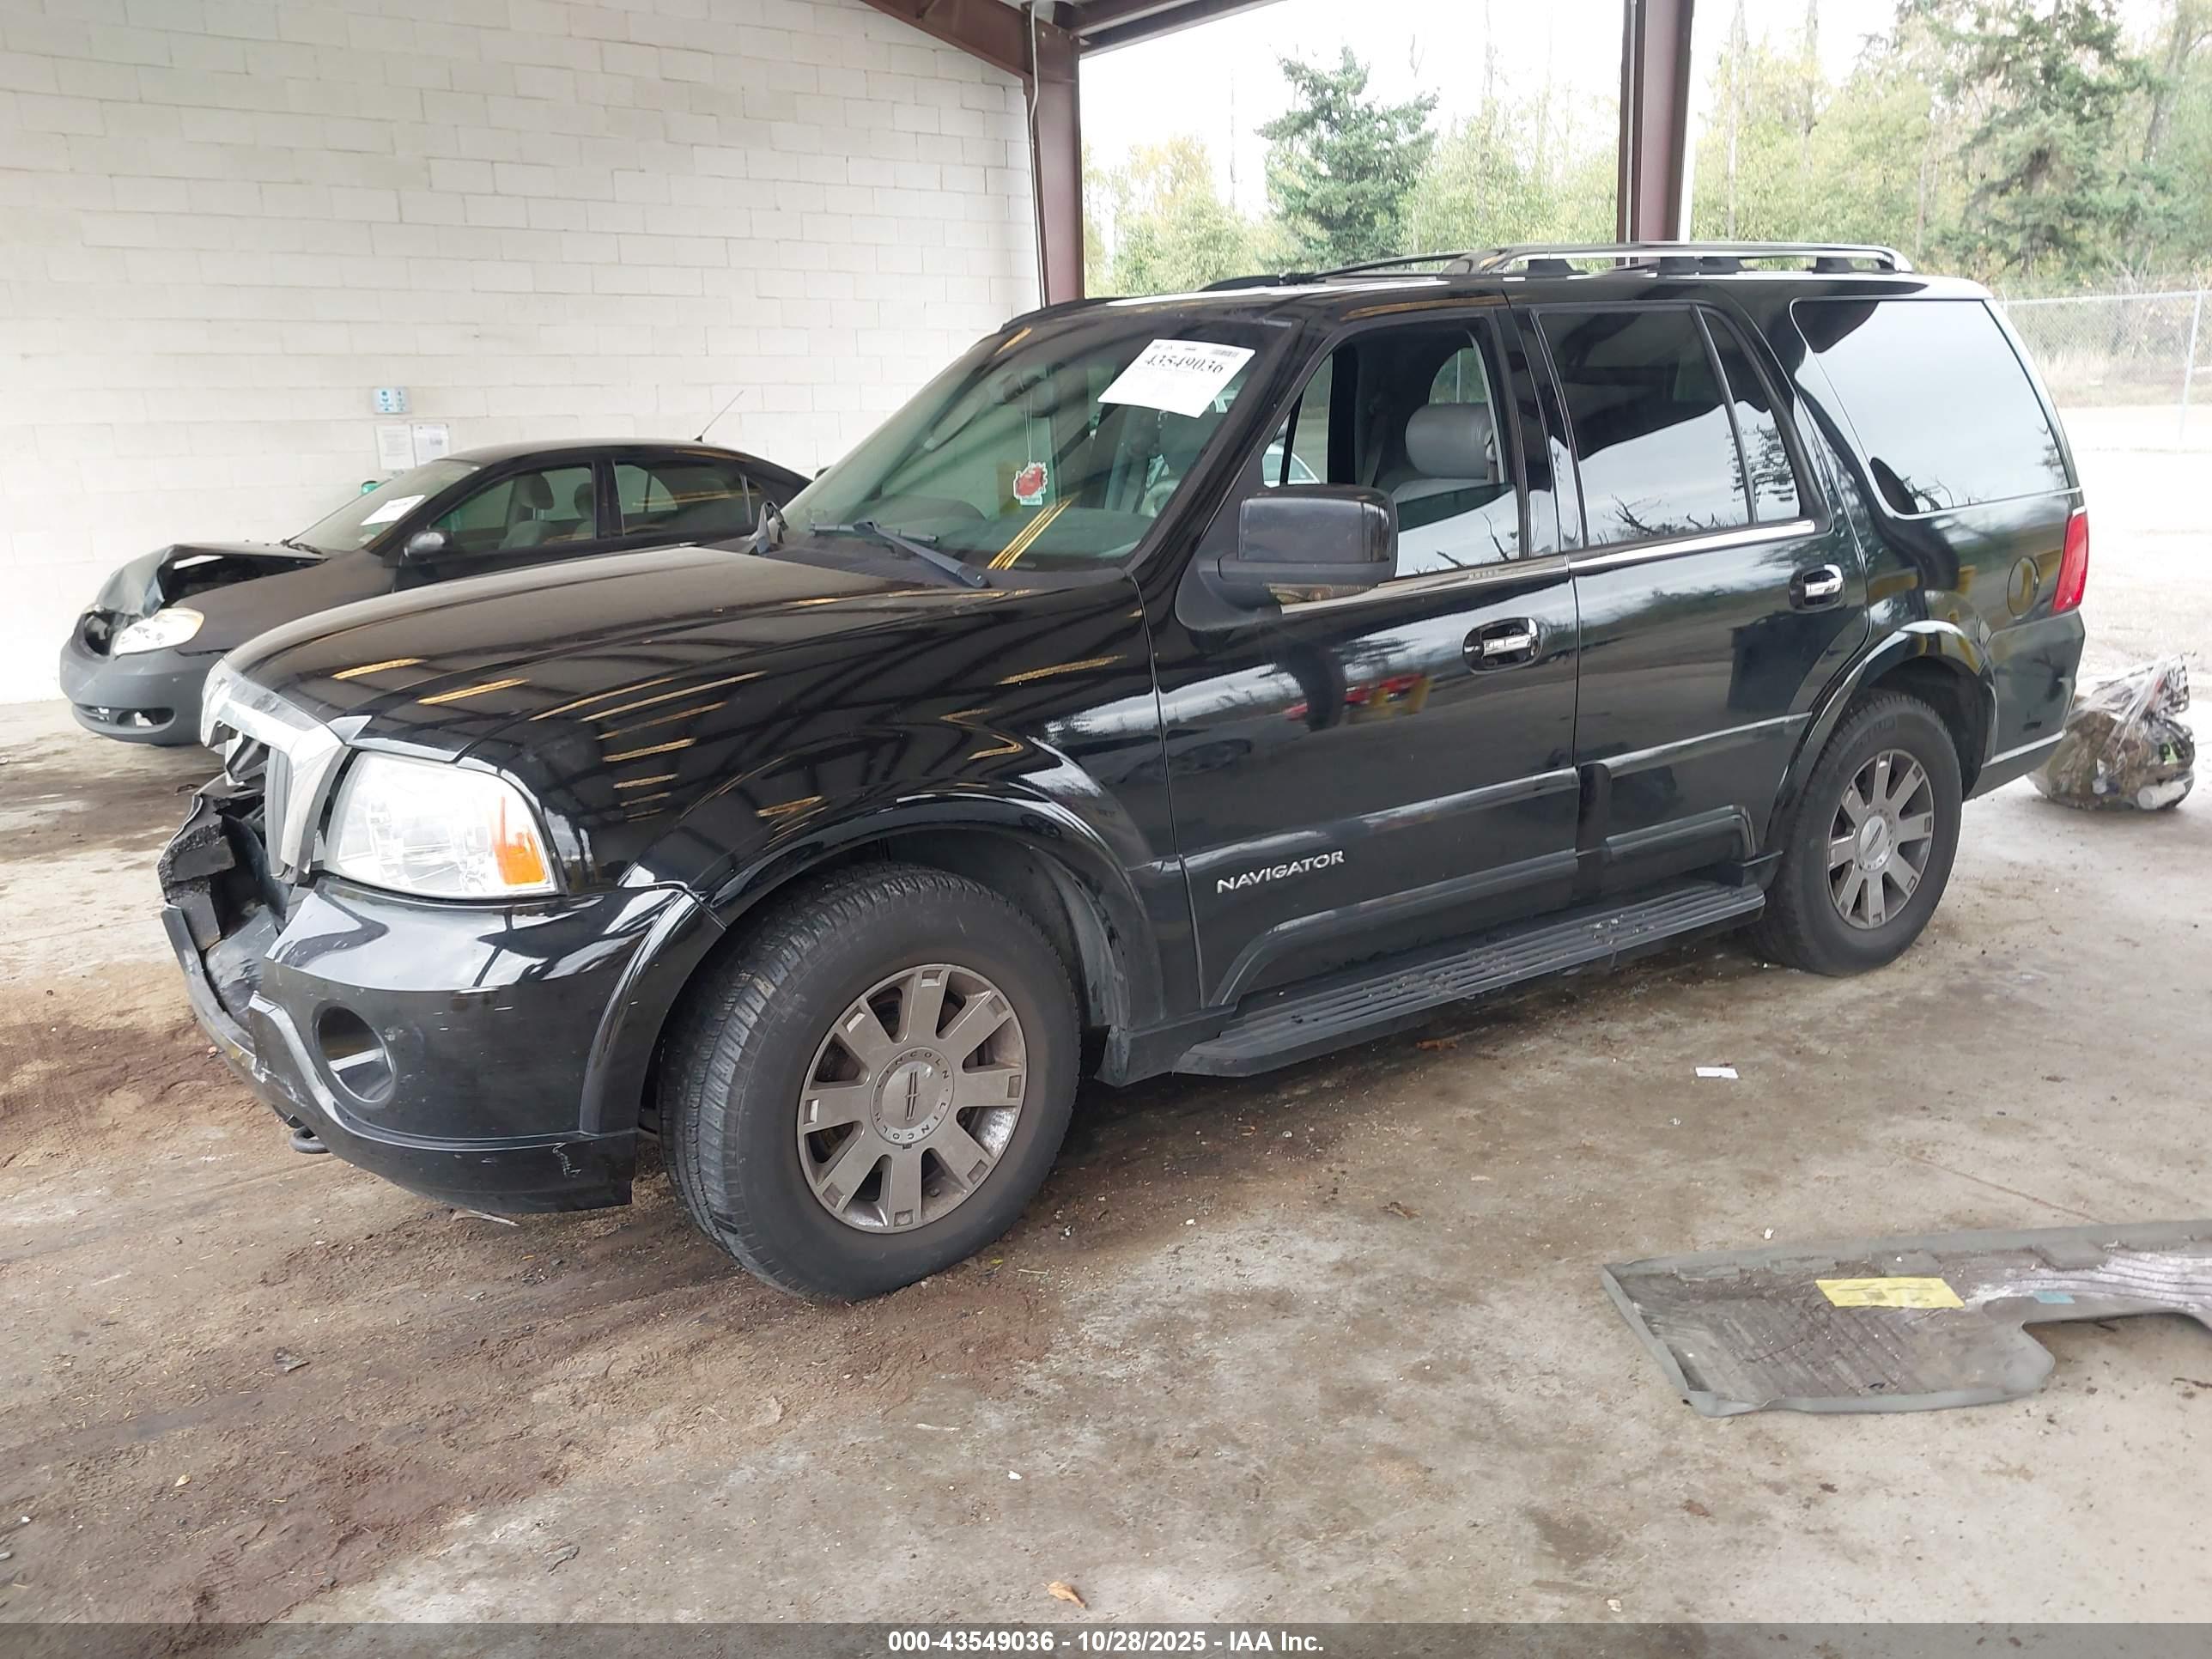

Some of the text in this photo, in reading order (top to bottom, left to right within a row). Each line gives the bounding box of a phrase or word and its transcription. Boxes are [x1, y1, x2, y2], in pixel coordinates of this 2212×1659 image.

[1145, 354, 1224, 374] 43549036
[1216, 849, 1346, 894] NAVIGATOR
[877, 1050, 950, 1088] LINCOLN
[874, 1102, 947, 1140] LINCOLN
